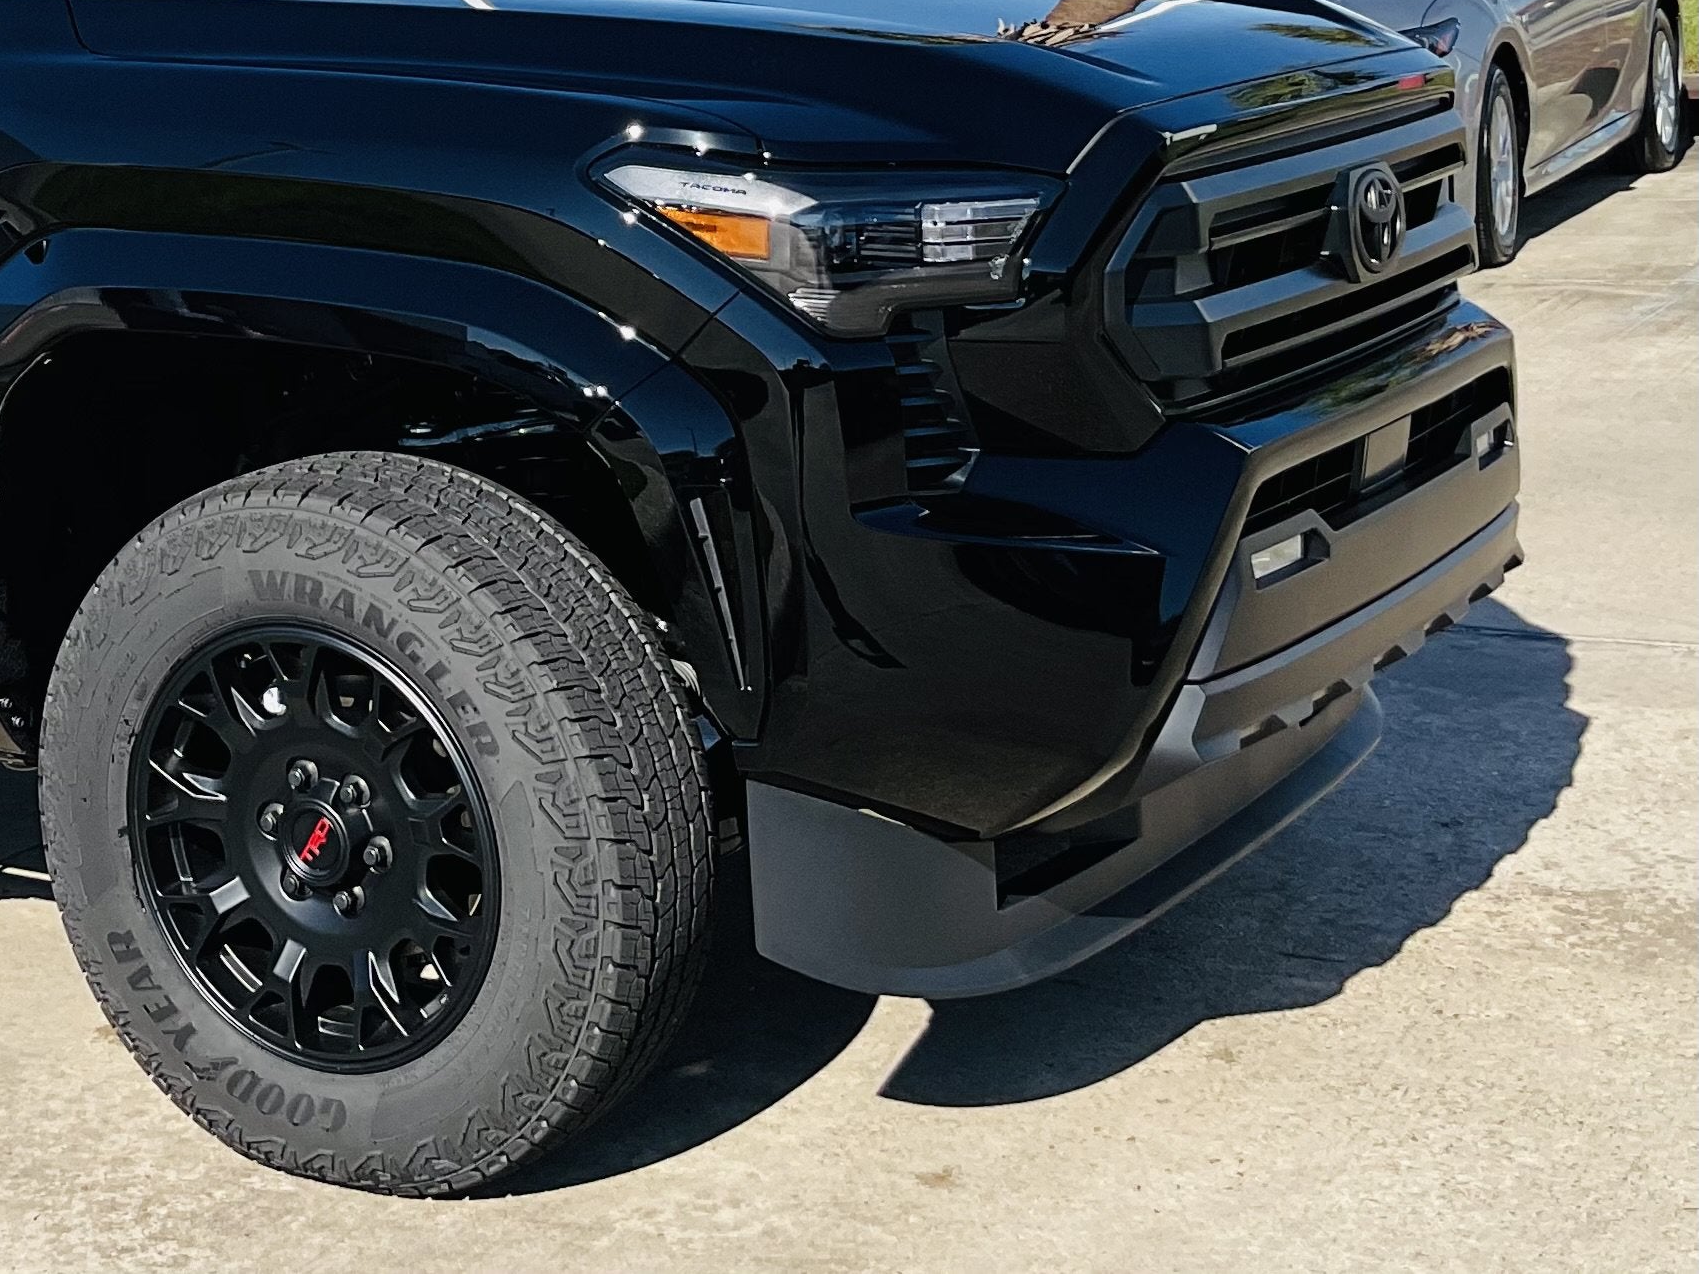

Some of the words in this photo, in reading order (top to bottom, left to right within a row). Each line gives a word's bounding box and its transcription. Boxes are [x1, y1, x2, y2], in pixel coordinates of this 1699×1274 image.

[679, 182, 747, 195] TACOMA
[247, 568, 501, 759] WRANGLER
[299, 816, 331, 862] TRD
